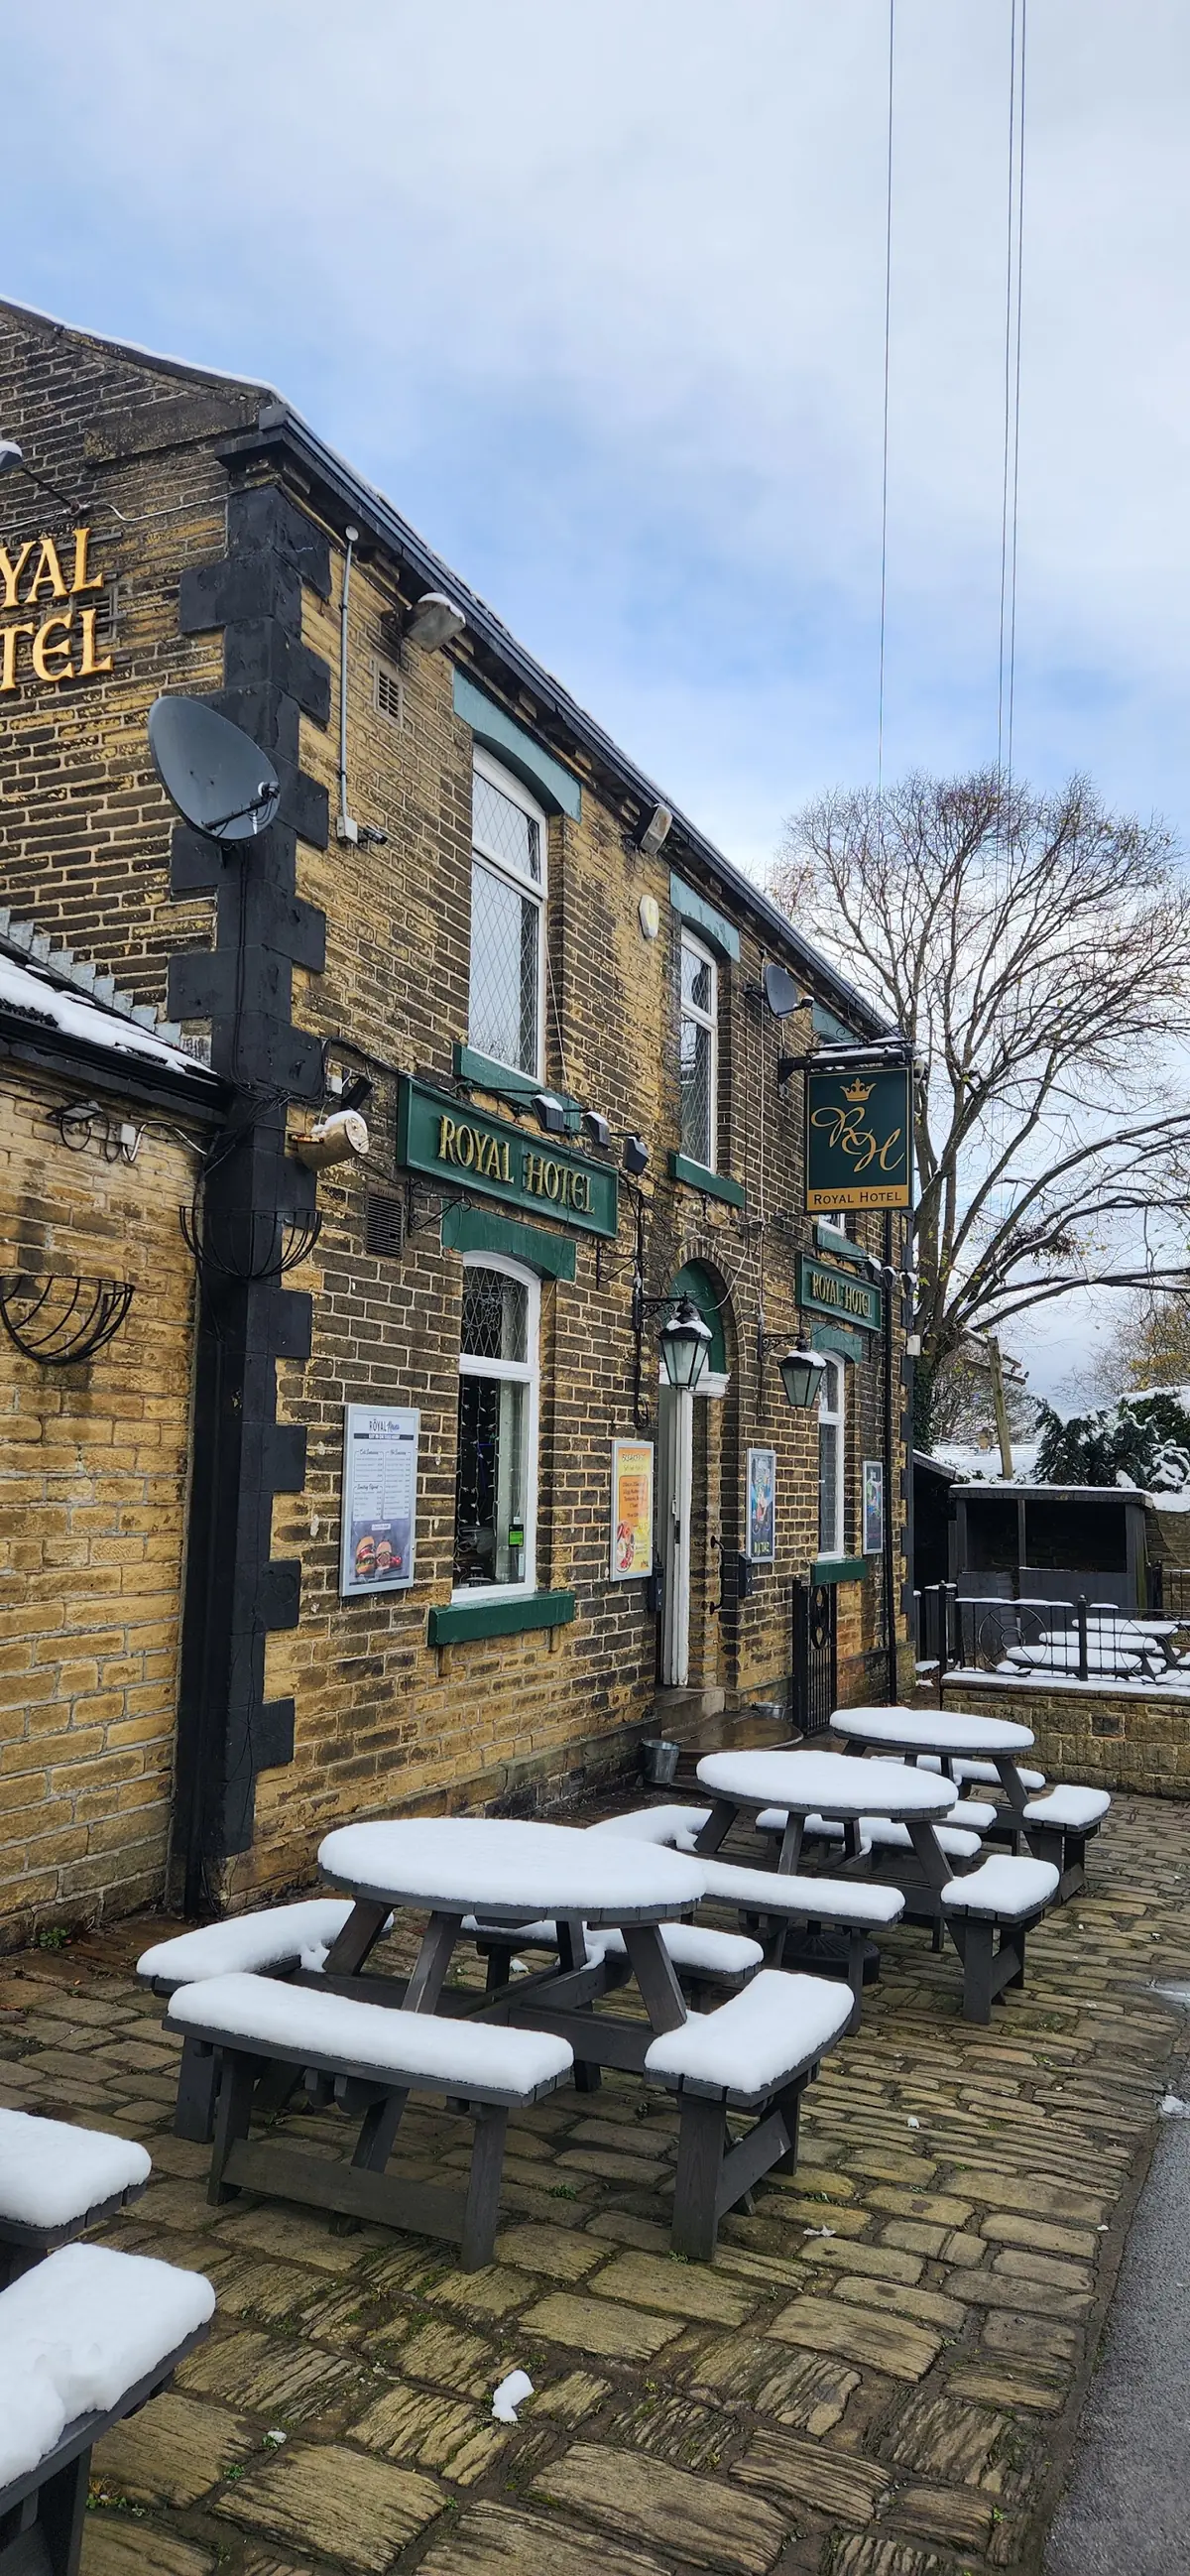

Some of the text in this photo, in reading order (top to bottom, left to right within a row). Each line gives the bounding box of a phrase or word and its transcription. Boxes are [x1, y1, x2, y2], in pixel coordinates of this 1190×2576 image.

[0, 527, 104, 608] YAL
[0, 608, 113, 691] TEL
[437, 1114, 595, 1215] ROYAL HOTEL
[813, 1191, 902, 1205] ROYAL HOTEL
[811, 1271, 873, 1318] ROYAL HOTEL
